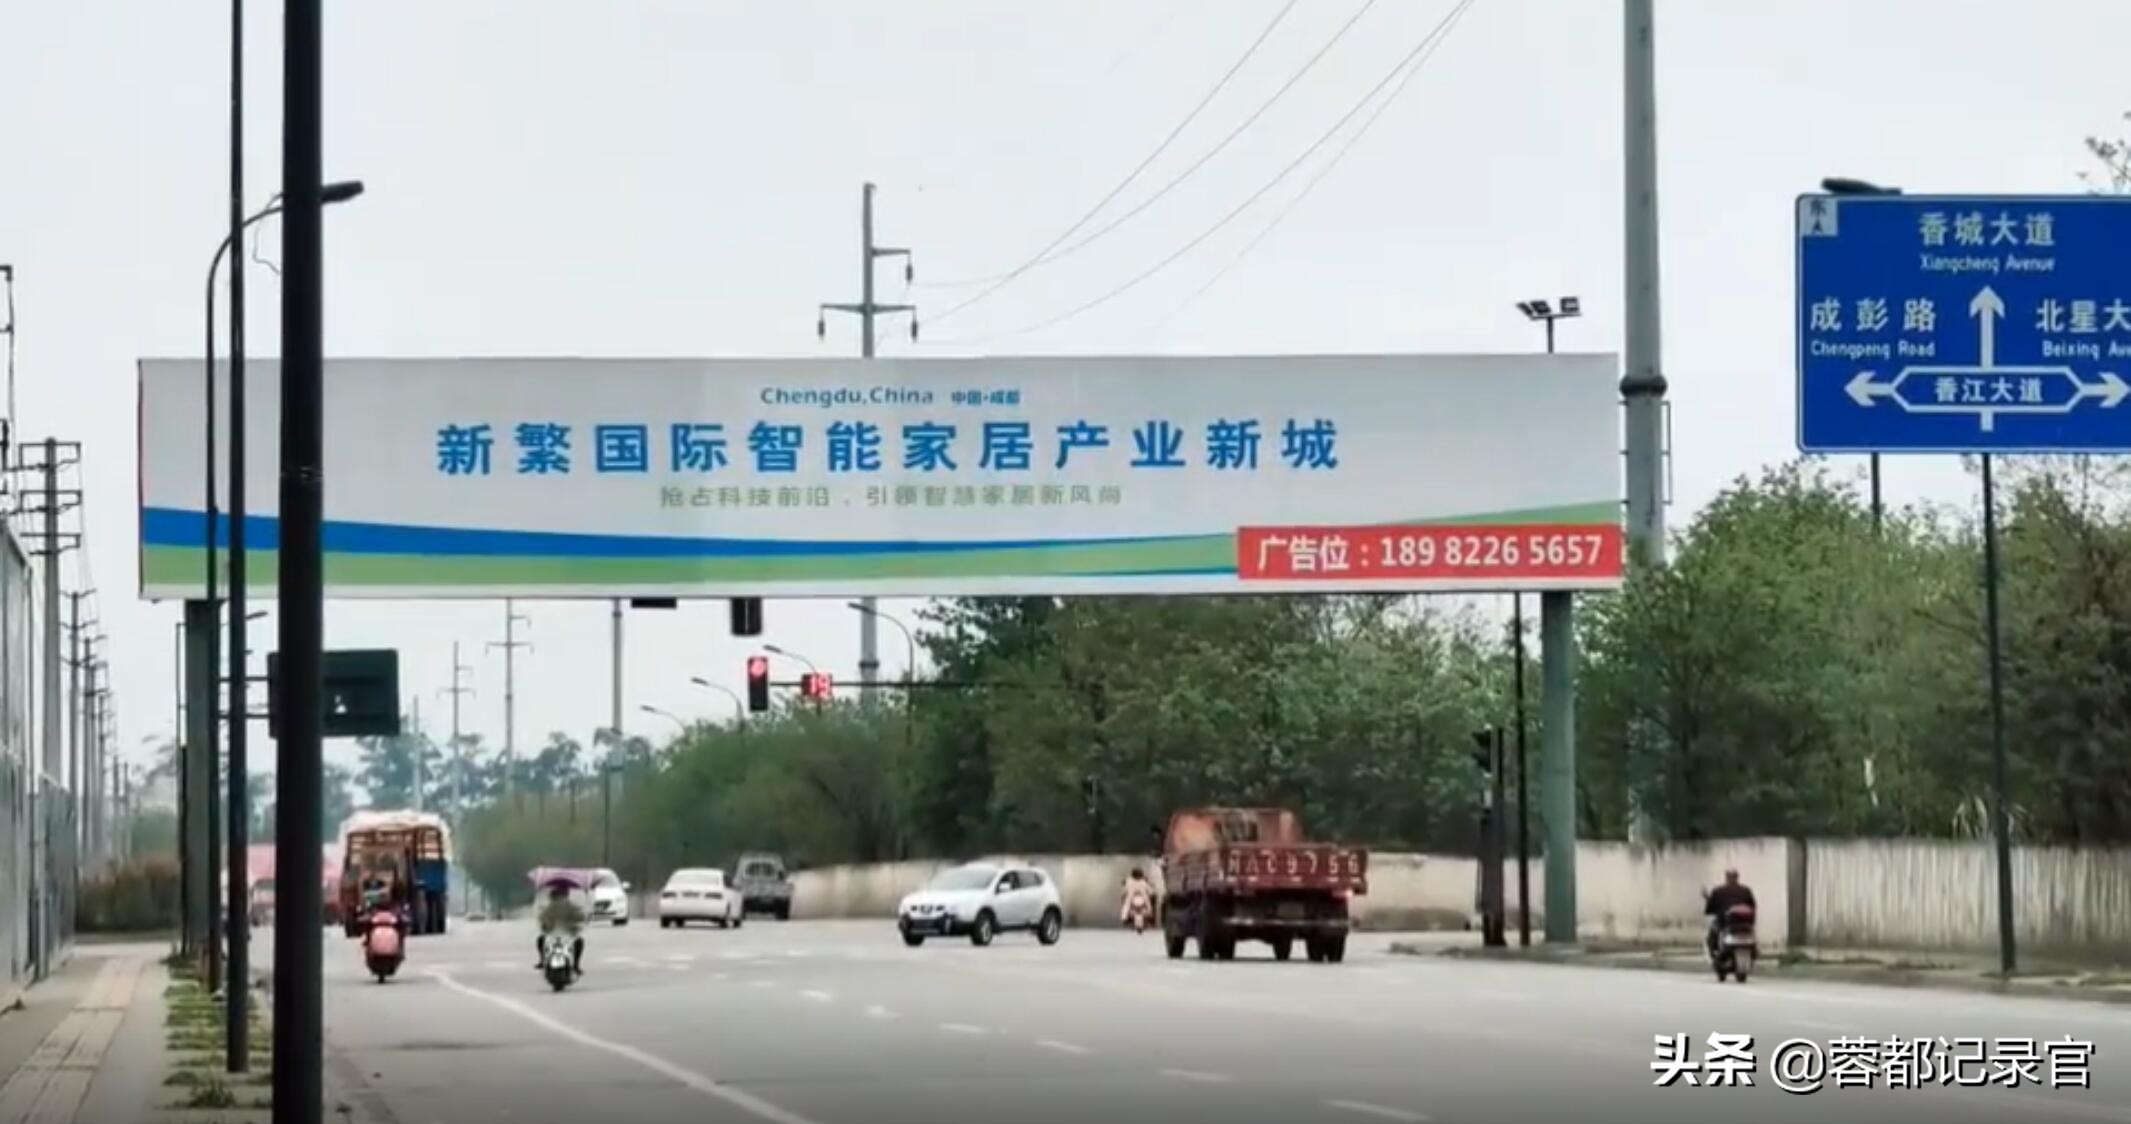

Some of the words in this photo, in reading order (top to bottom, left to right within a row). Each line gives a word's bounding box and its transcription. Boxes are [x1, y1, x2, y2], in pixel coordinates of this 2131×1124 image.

[1919, 212, 2055, 246] 香城大道
[1919, 254, 2000, 275] Xiangcheng
[2004, 254, 2056, 271] Avenue
[1810, 297, 1937, 332] 成彭路
[2035, 298, 2131, 333] 北星大
[1810, 340, 1891, 360] Chengpeng
[1898, 340, 1936, 357] Road
[2042, 340, 2100, 361] Beixing
[760, 386, 934, 408] Chengdu,China
[1935, 378, 2043, 402] 香江大道
[436, 418, 1339, 476] 新繁国际智能家居产业新城
[1380, 536, 1437, 566] 189
[1444, 535, 1520, 565] 8226
[1528, 534, 1604, 565] 5657
